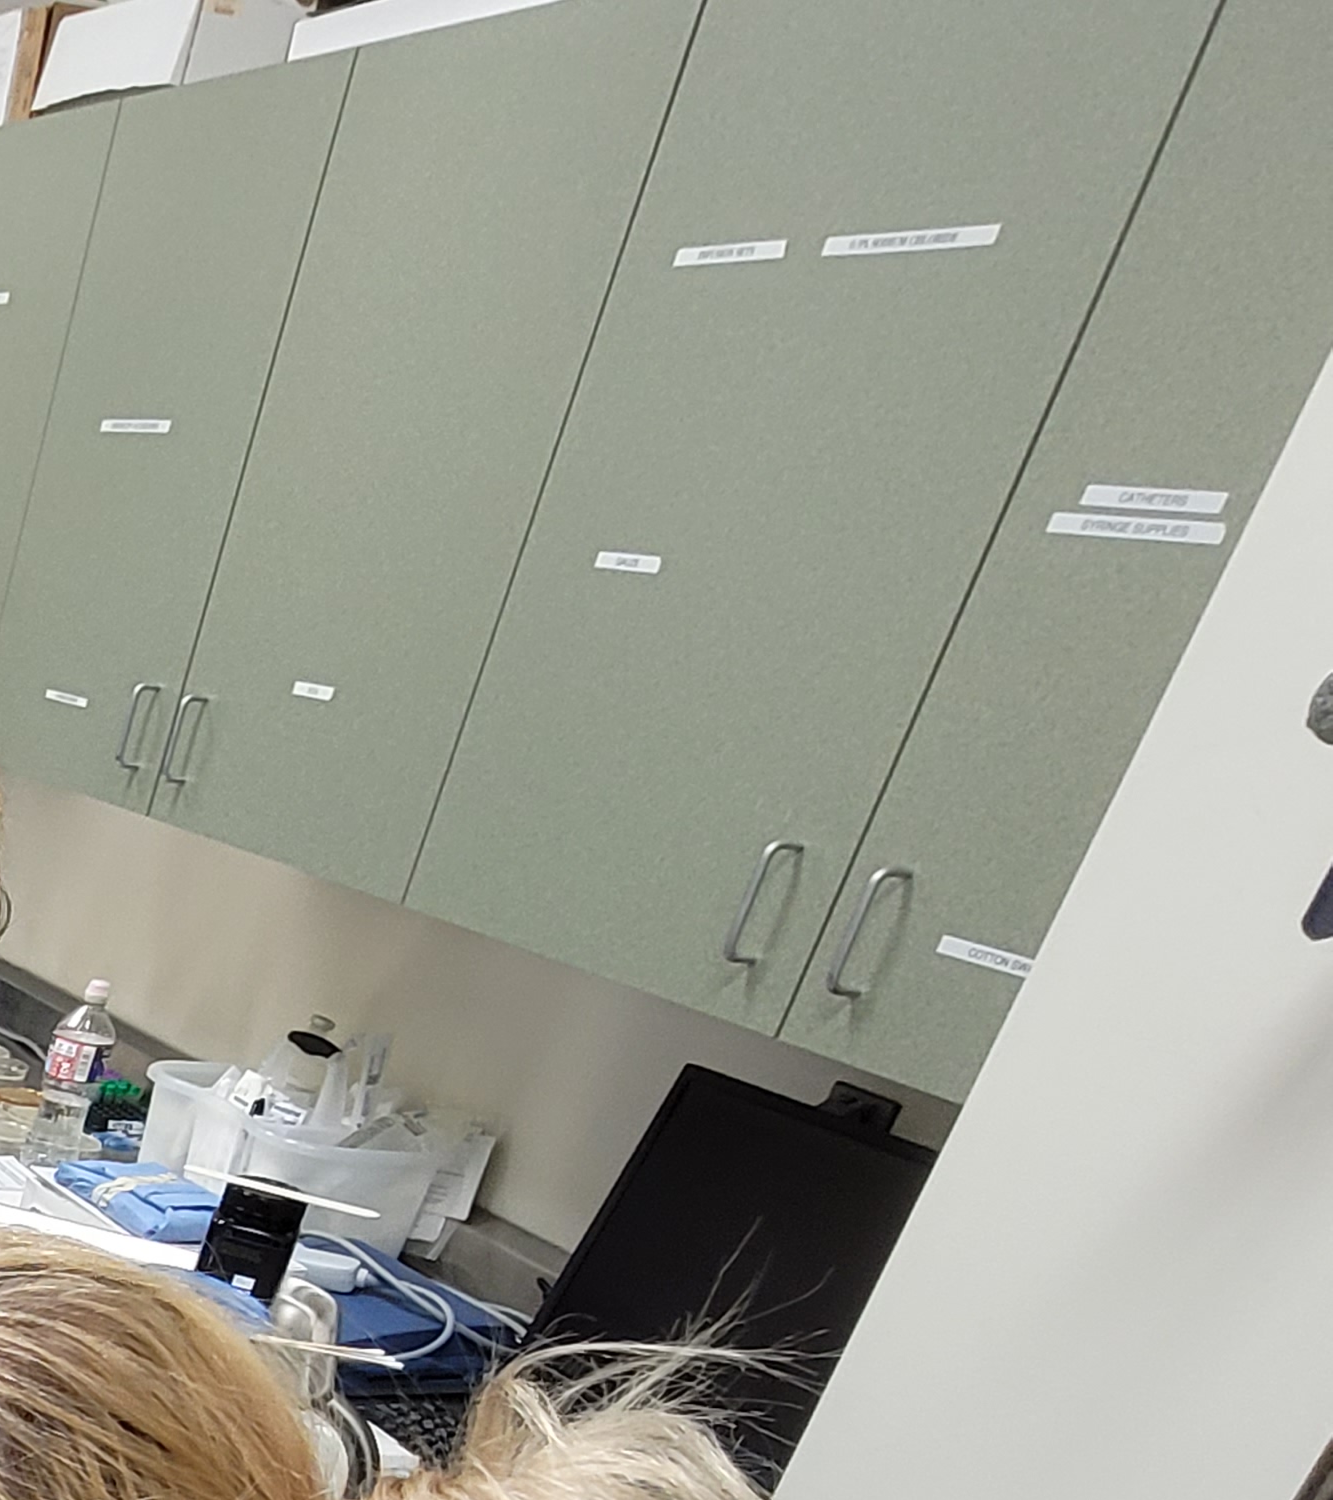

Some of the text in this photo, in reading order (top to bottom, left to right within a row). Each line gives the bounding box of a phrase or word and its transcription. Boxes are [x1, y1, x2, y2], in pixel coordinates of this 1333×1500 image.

[1118, 491, 1189, 507] CATHETERS
[1081, 519, 1190, 538] SYRINGE SUPPLIES
[967, 947, 1009, 967] COTTON
